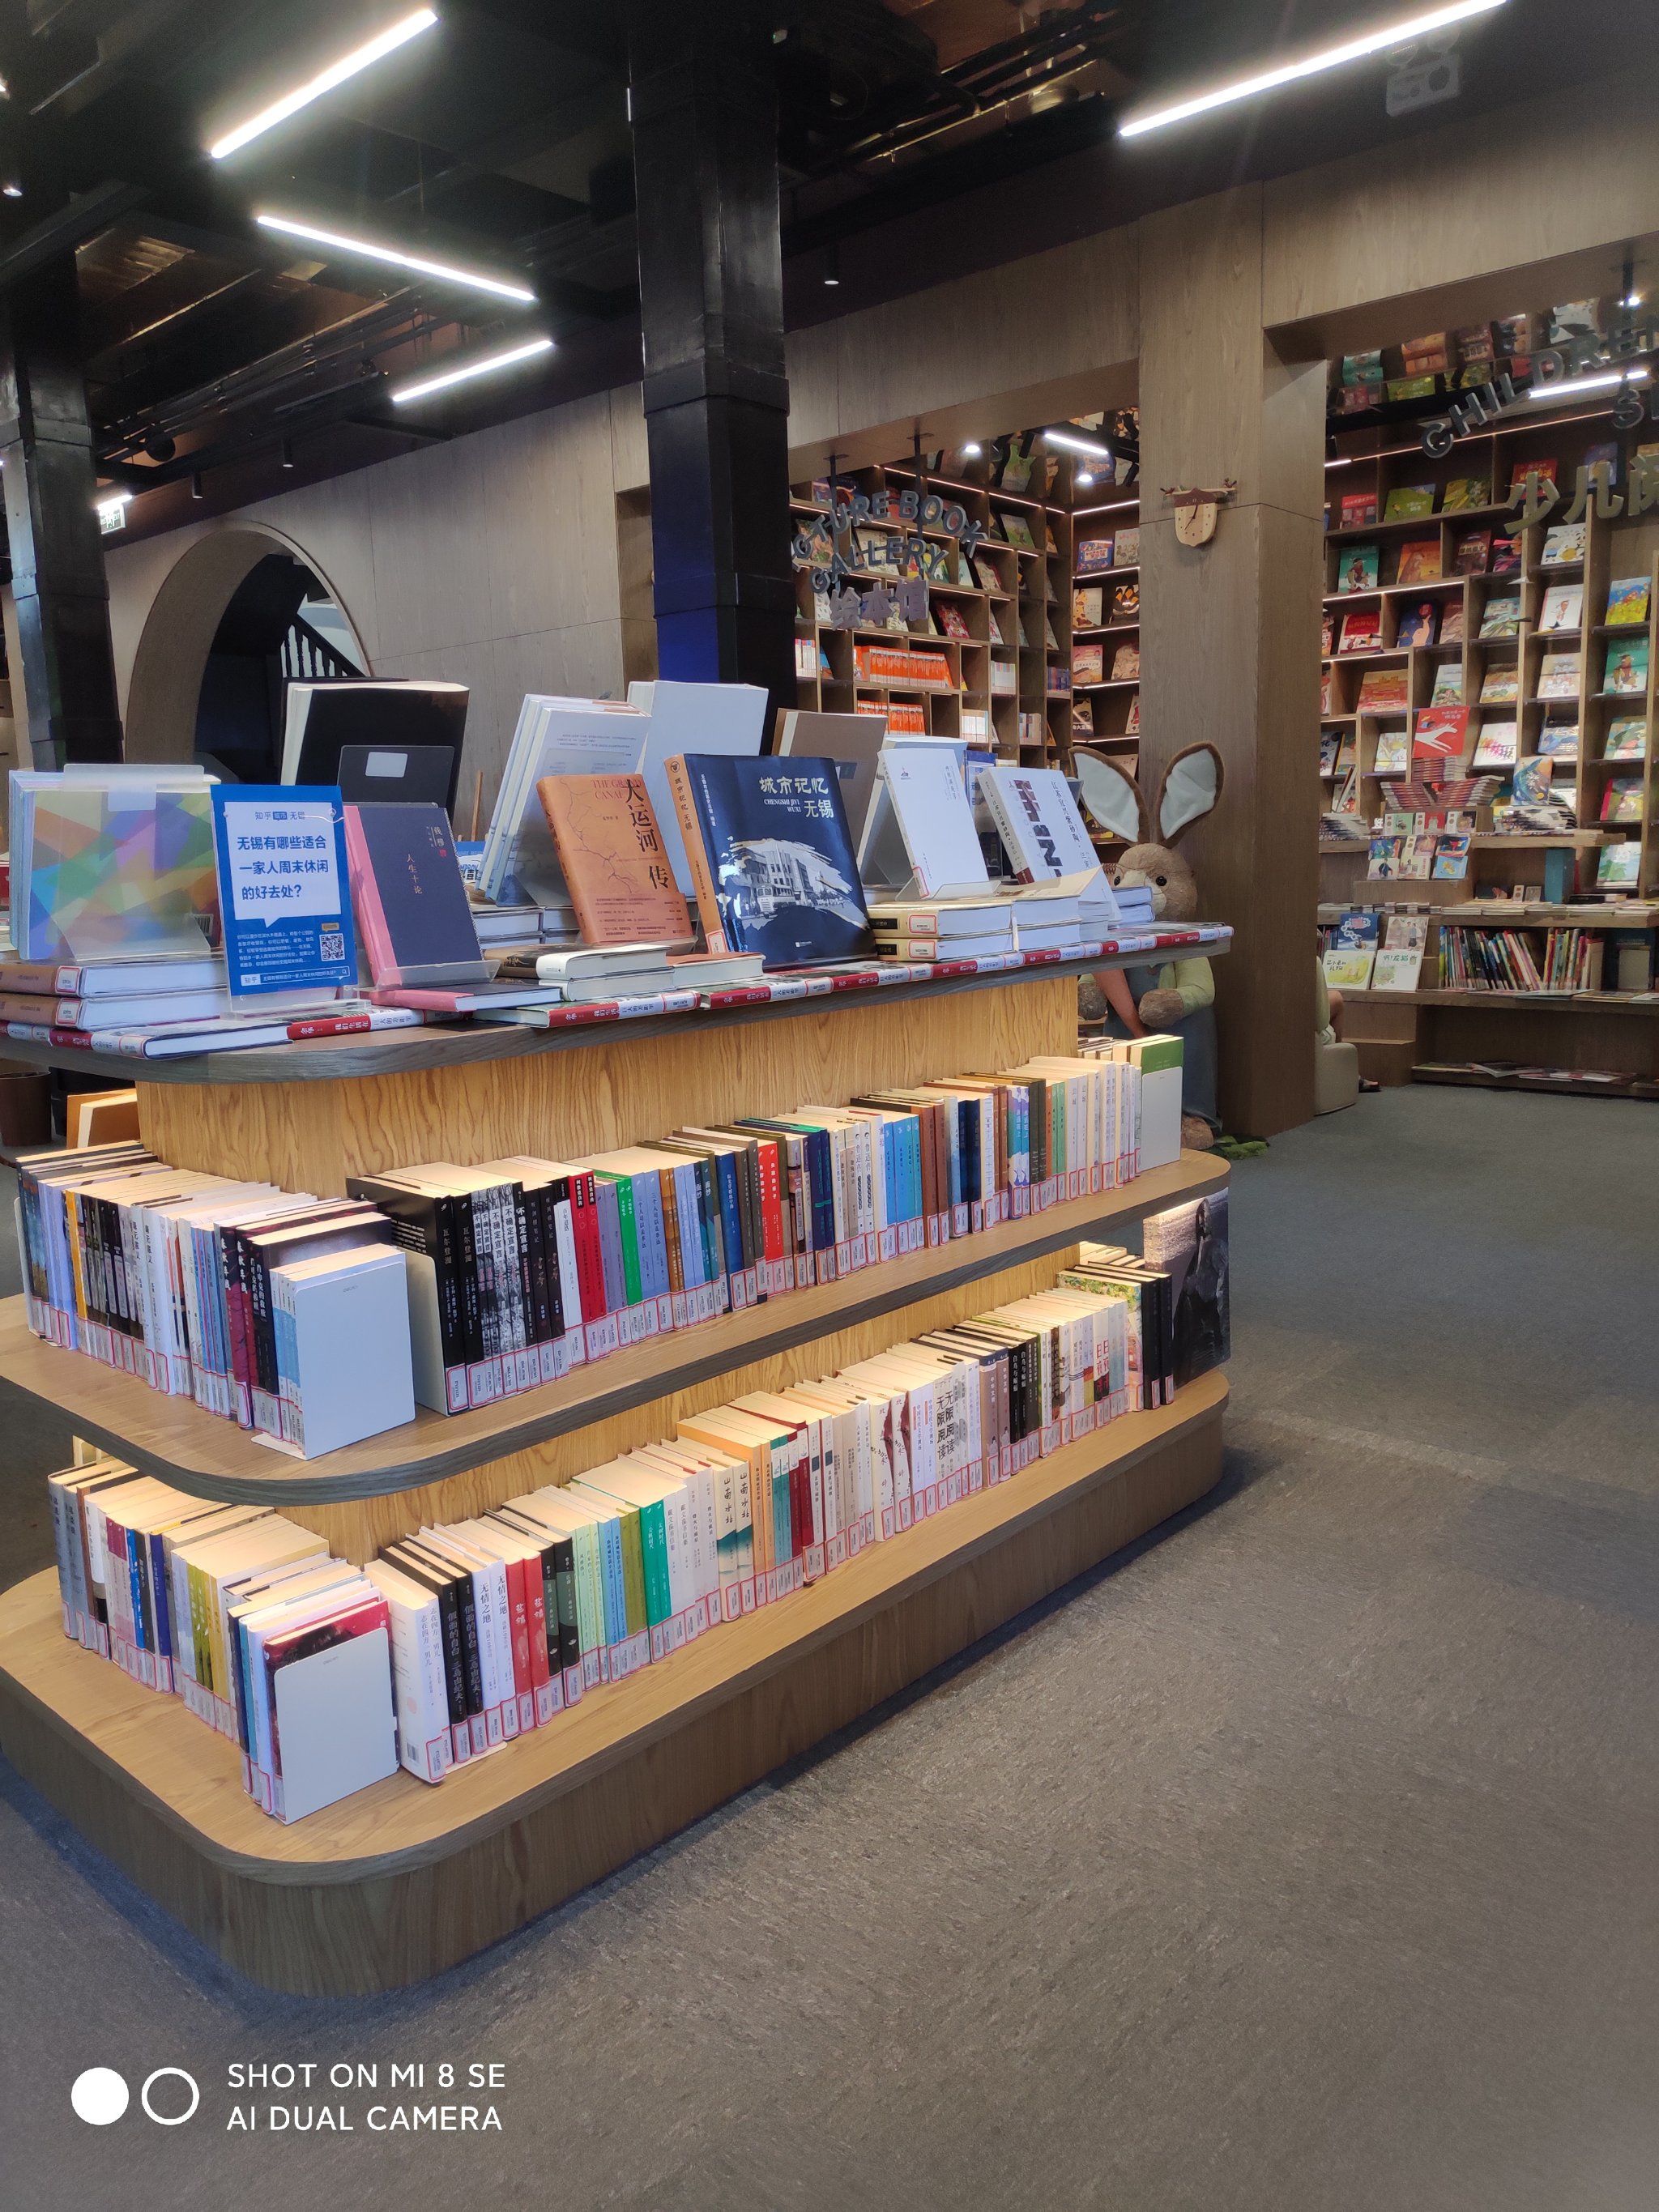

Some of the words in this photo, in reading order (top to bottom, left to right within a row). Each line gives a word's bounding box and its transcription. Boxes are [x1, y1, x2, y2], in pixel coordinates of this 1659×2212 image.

[899, 490, 988, 559] BOOK
[810, 535, 949, 594] GALLERY
[830, 576, 930, 631] 绘本馆
[759, 776, 830, 795] 城市记忆
[804, 799, 834, 819] 无锡
[237, 835, 326, 850] 无锡有哪些适合
[239, 859, 329, 875] 一家人周末休闲
[492, 1211, 502, 1259] 不确定宣言
[505, 1208, 515, 1255] 不确定宣言
[480, 1582, 492, 1624] 无情之地
[497, 1573, 507, 1615] 无情之地
